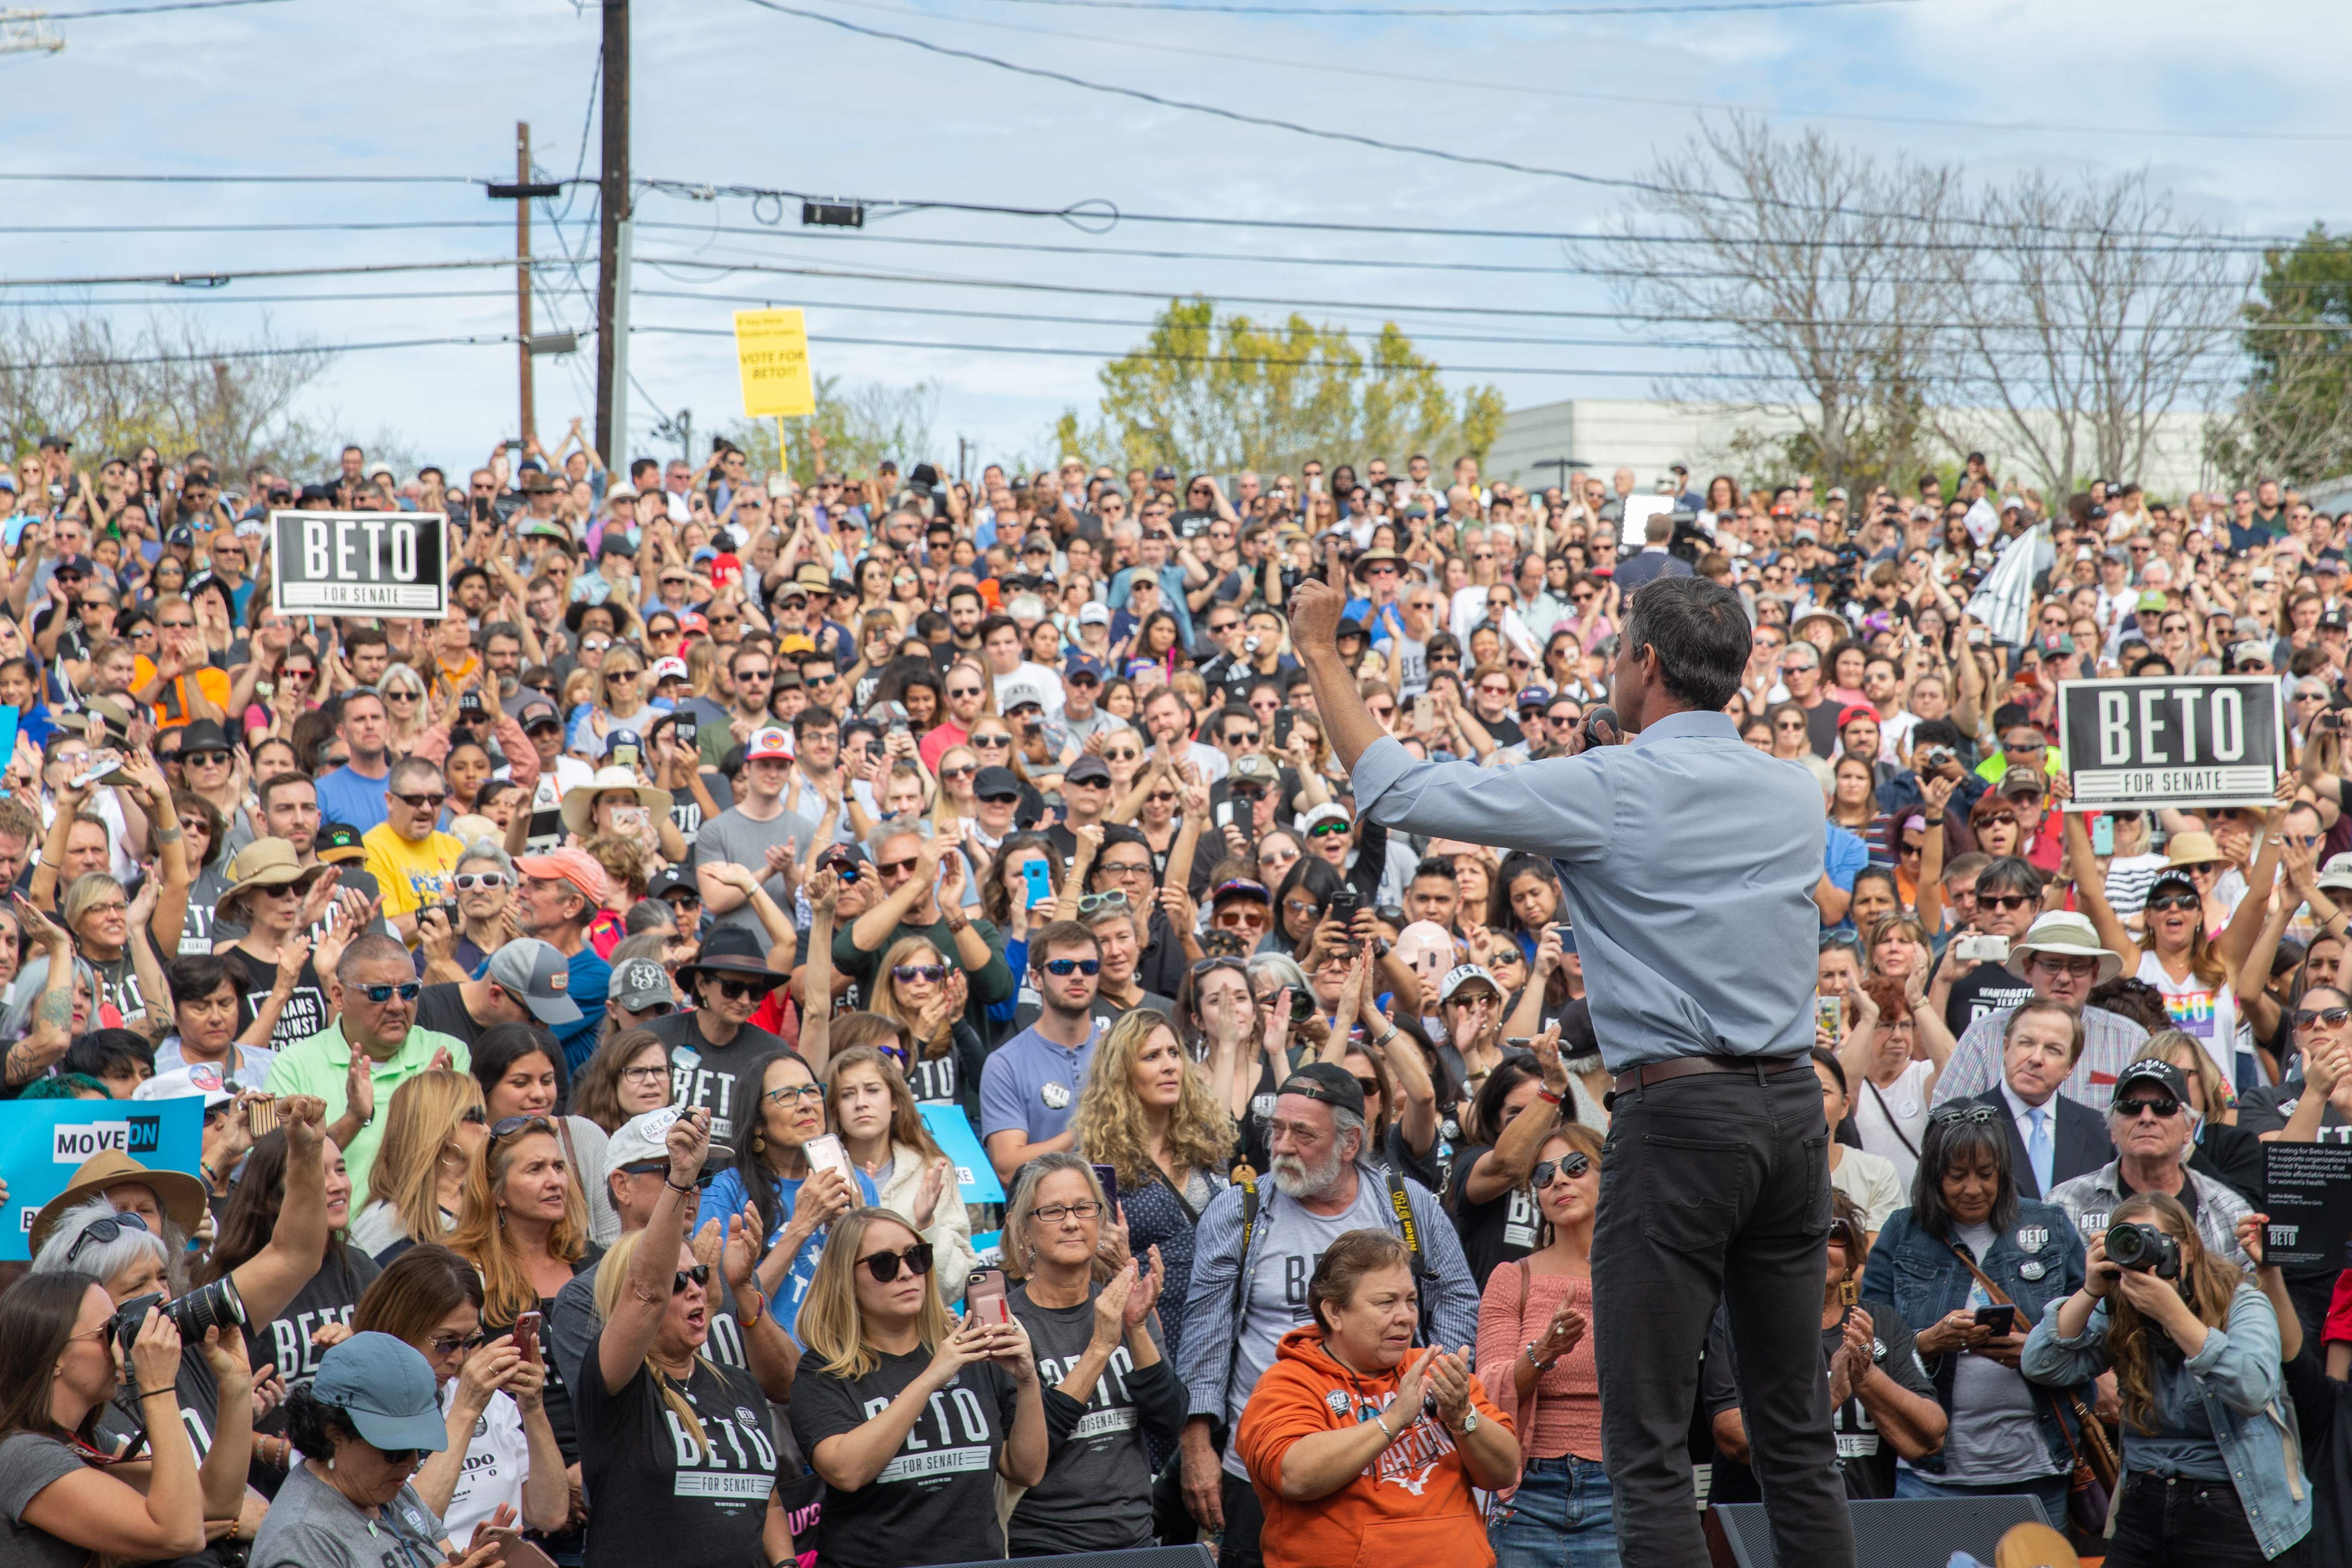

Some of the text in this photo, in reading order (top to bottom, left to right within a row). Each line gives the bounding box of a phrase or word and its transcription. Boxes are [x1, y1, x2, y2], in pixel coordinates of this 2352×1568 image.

[741, 349, 805, 364] VOTE FOR
[752, 366, 797, 380] BETO!!
[304, 520, 418, 581] BETO
[324, 585, 399, 604] FOR SENATE
[2098, 688, 2244, 765] BETO
[2125, 770, 2222, 793] FOR SENATE
[2166, 993, 2207, 1022] ETO
[673, 1068, 736, 1117] BET
[1043, 1083, 1070, 1100] BETO
[2293, 1170, 2325, 1178] affordable
[2294, 1163, 2331, 1171] Parenthood,
[1393, 1191, 1418, 1252] Nikon D750
[2081, 1213, 2109, 1228] BETO
[2019, 1229, 2049, 1243] BETO
[2270, 1232, 2295, 1246] BETO
[2020, 1262, 2041, 1273] BETO
[1090, 1412, 1121, 1431] SENATE
[665, 1410, 777, 1471] BETO
[903, 1453, 963, 1474] FOR SENATE
[702, 1478, 756, 1493] FOR SENATE
